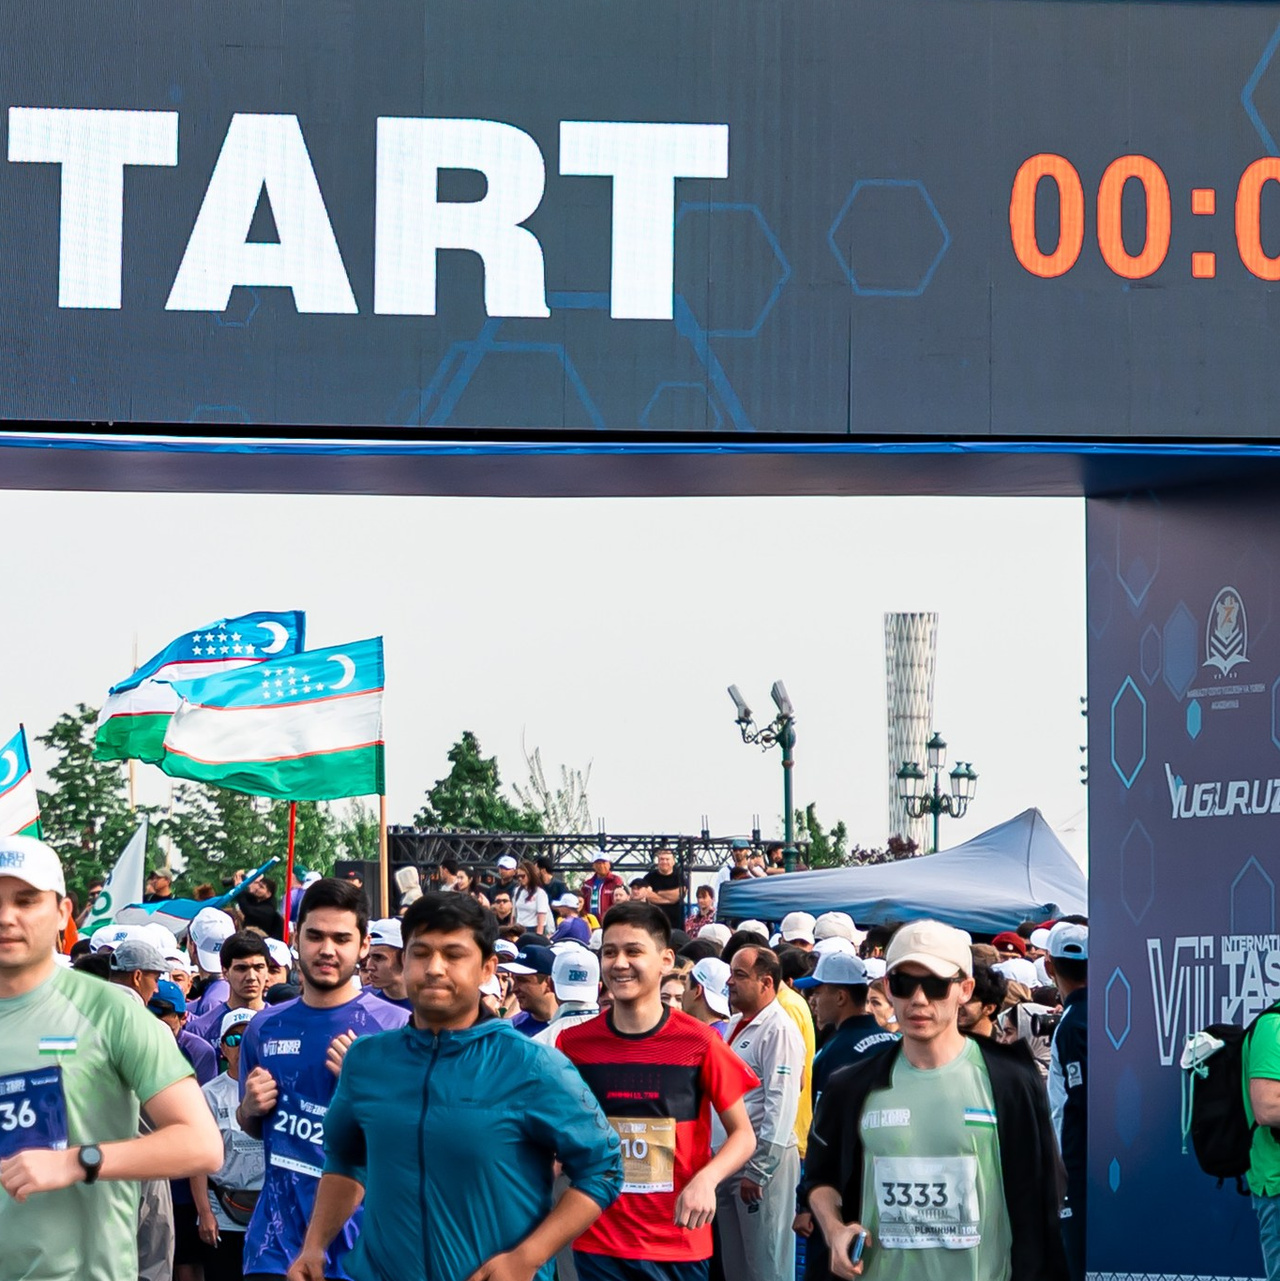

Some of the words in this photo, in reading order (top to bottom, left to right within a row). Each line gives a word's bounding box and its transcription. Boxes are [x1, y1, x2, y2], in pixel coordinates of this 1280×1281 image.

[273, 1110, 325, 1146] 2102
[882, 1181, 949, 1208] 3333
[914, 1223, 957, 1236] PLATINUM
